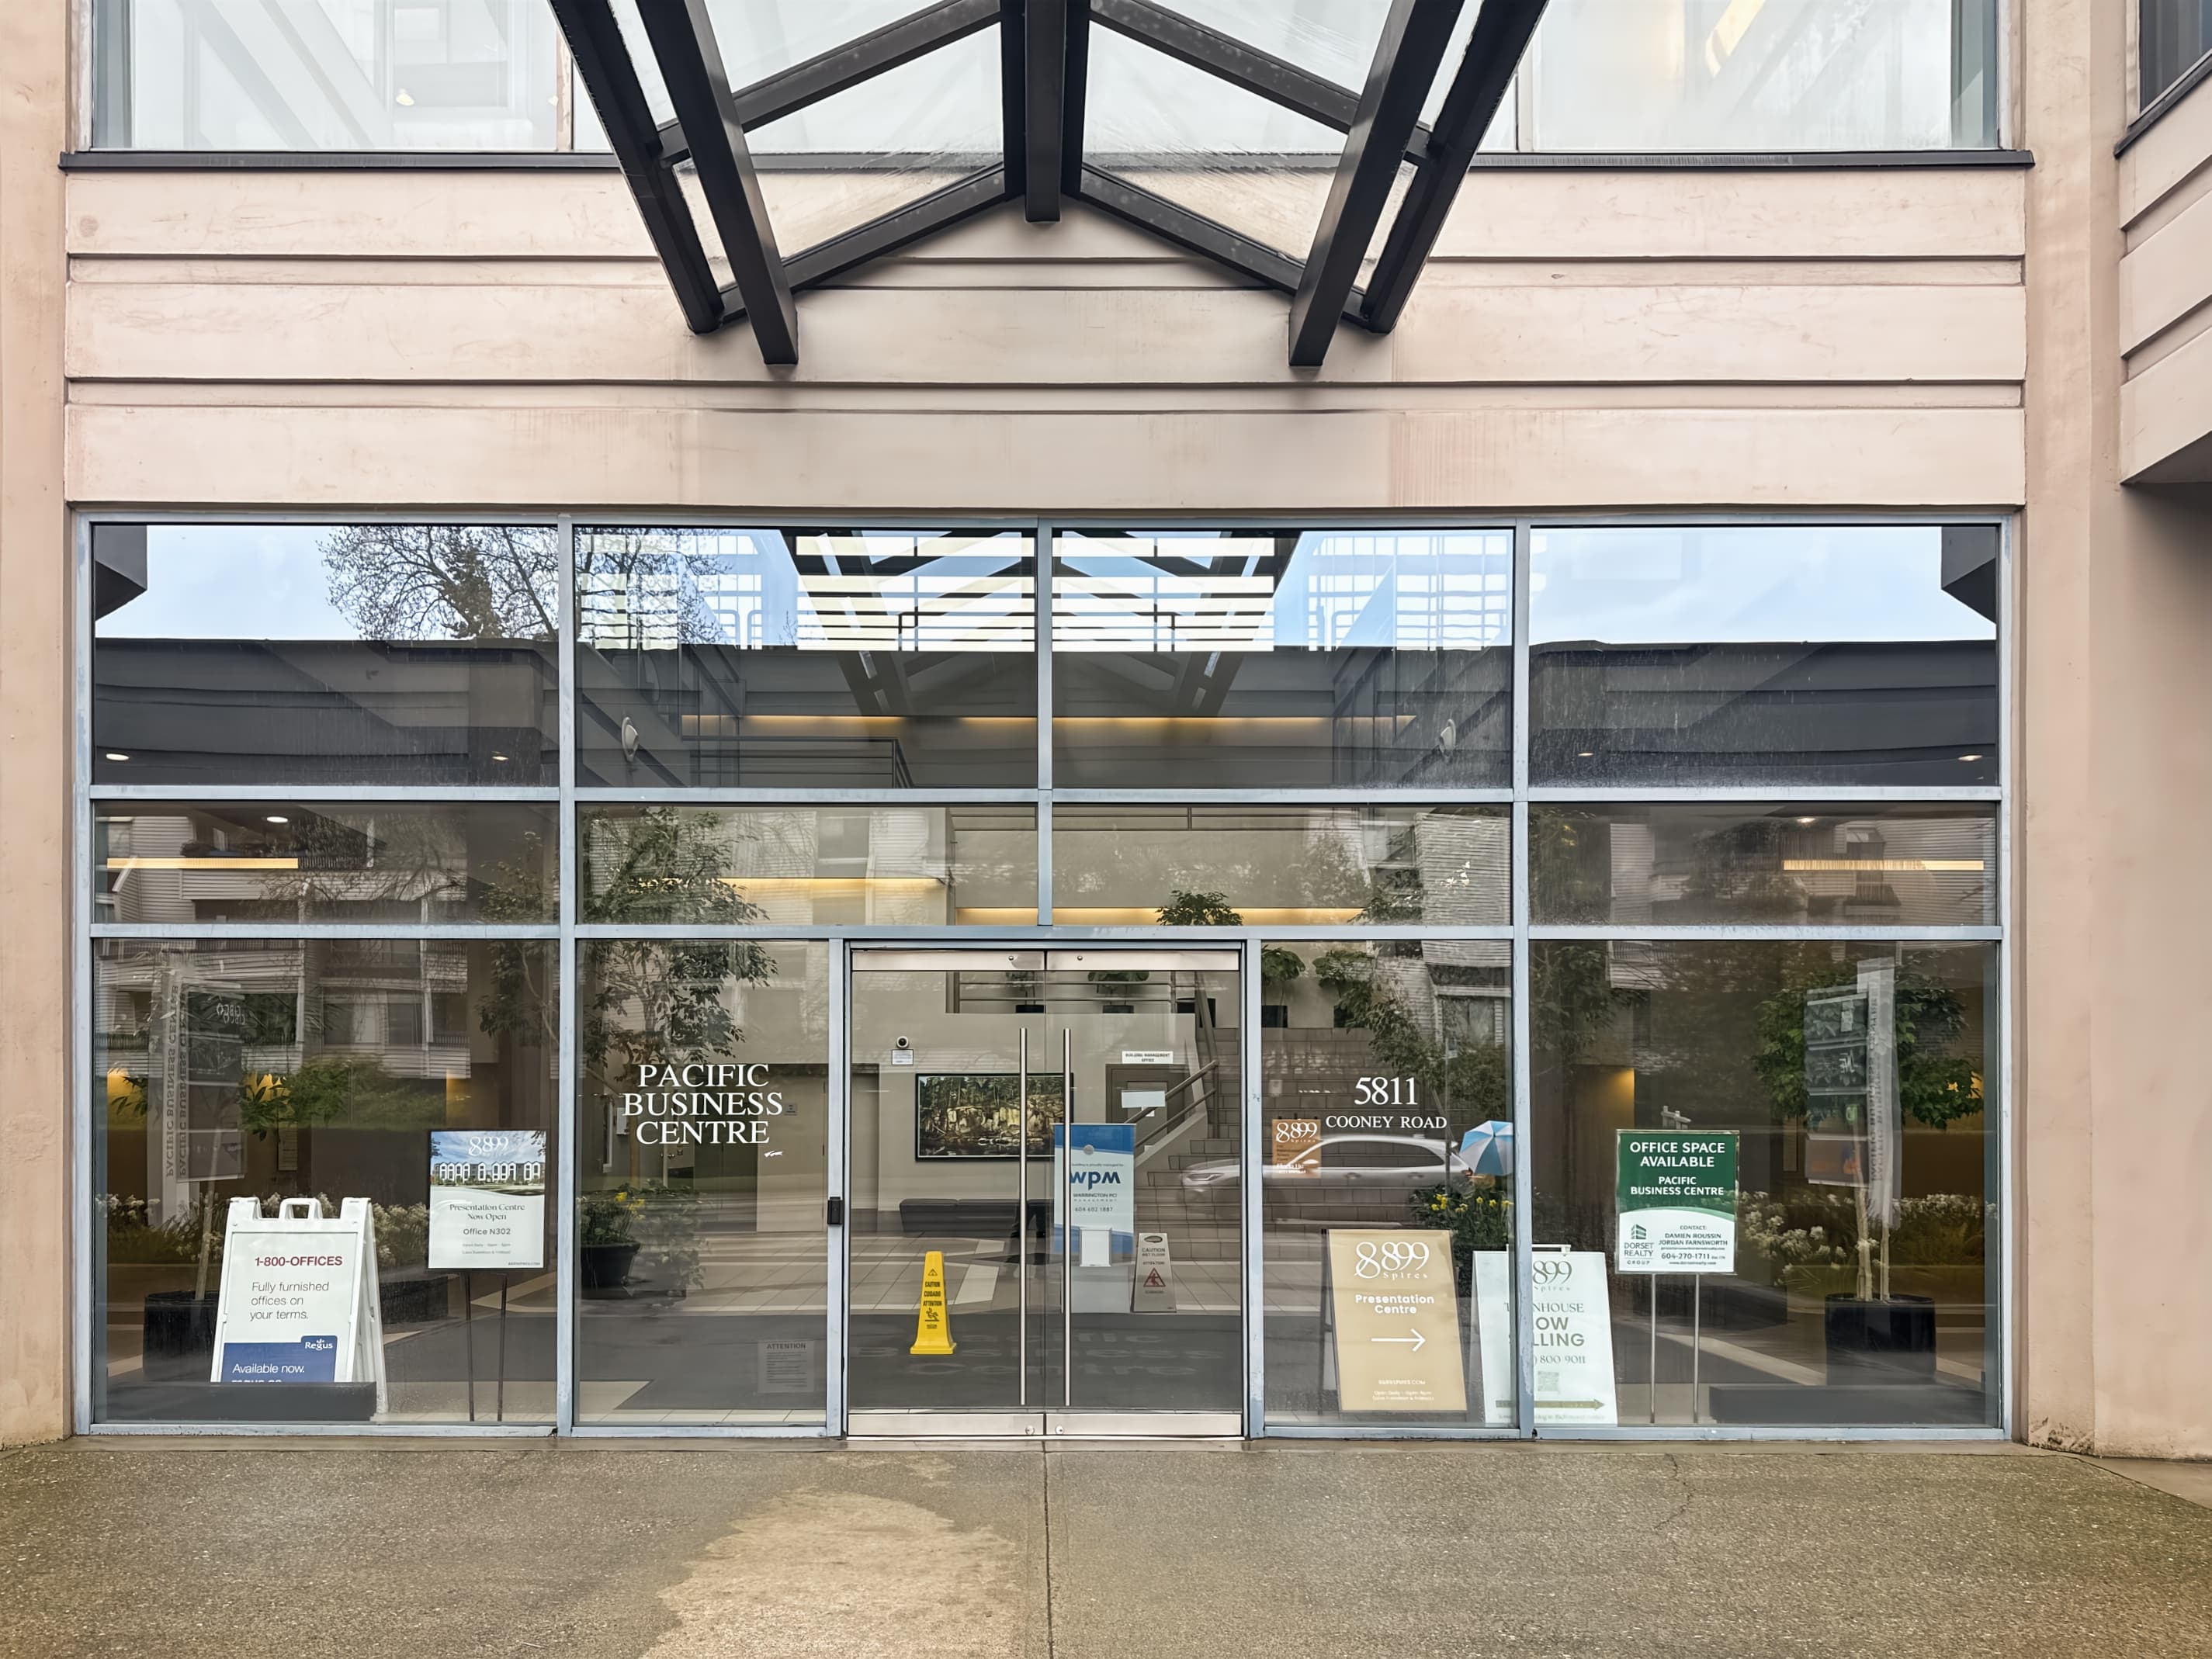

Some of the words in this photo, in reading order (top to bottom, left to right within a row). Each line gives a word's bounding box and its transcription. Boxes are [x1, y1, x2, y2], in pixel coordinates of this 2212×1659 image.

[637, 1064, 770, 1087] PACIFIC
[1354, 1076, 1418, 1105] 5811
[622, 1092, 783, 1116] BUSINESS
[1326, 1115, 1394, 1128] COONEY
[1400, 1116, 1448, 1129] ROAD
[636, 1120, 770, 1145] CENTRE
[1276, 1122, 1318, 1143] 8899
[468, 1136, 508, 1156] 8899
[1630, 1141, 1678, 1153] OFFICE
[1682, 1142, 1725, 1153] SPACE
[1640, 1156, 1714, 1167] AVAILABLE
[1070, 1171, 1121, 1191] wpm
[1659, 1176, 1697, 1185] PACIFIC
[1631, 1186, 1681, 1195] BUSINESS
[1684, 1186, 1725, 1196] CENTRE
[485, 1213, 507, 1222] Open
[255, 1256, 343, 1266] 1-800-OFFICES
[1354, 1242, 1430, 1279] 8899
[1383, 1272, 1428, 1280] Spires
[1533, 1260, 1572, 1285] 899
[251, 1282, 276, 1294] Fully
[279, 1282, 330, 1292] furnished
[251, 1296, 286, 1306] offices
[1355, 1294, 1435, 1304] Presentation
[1375, 1305, 1416, 1314] Centre
[1504, 1303, 1584, 1313] TNHOUSE
[250, 1311, 273, 1321] your
[276, 1311, 309, 1319] terms.
[1535, 1317, 1569, 1330] OW
[304, 1339, 334, 1351] Regus
[232, 1363, 279, 1373] Available
